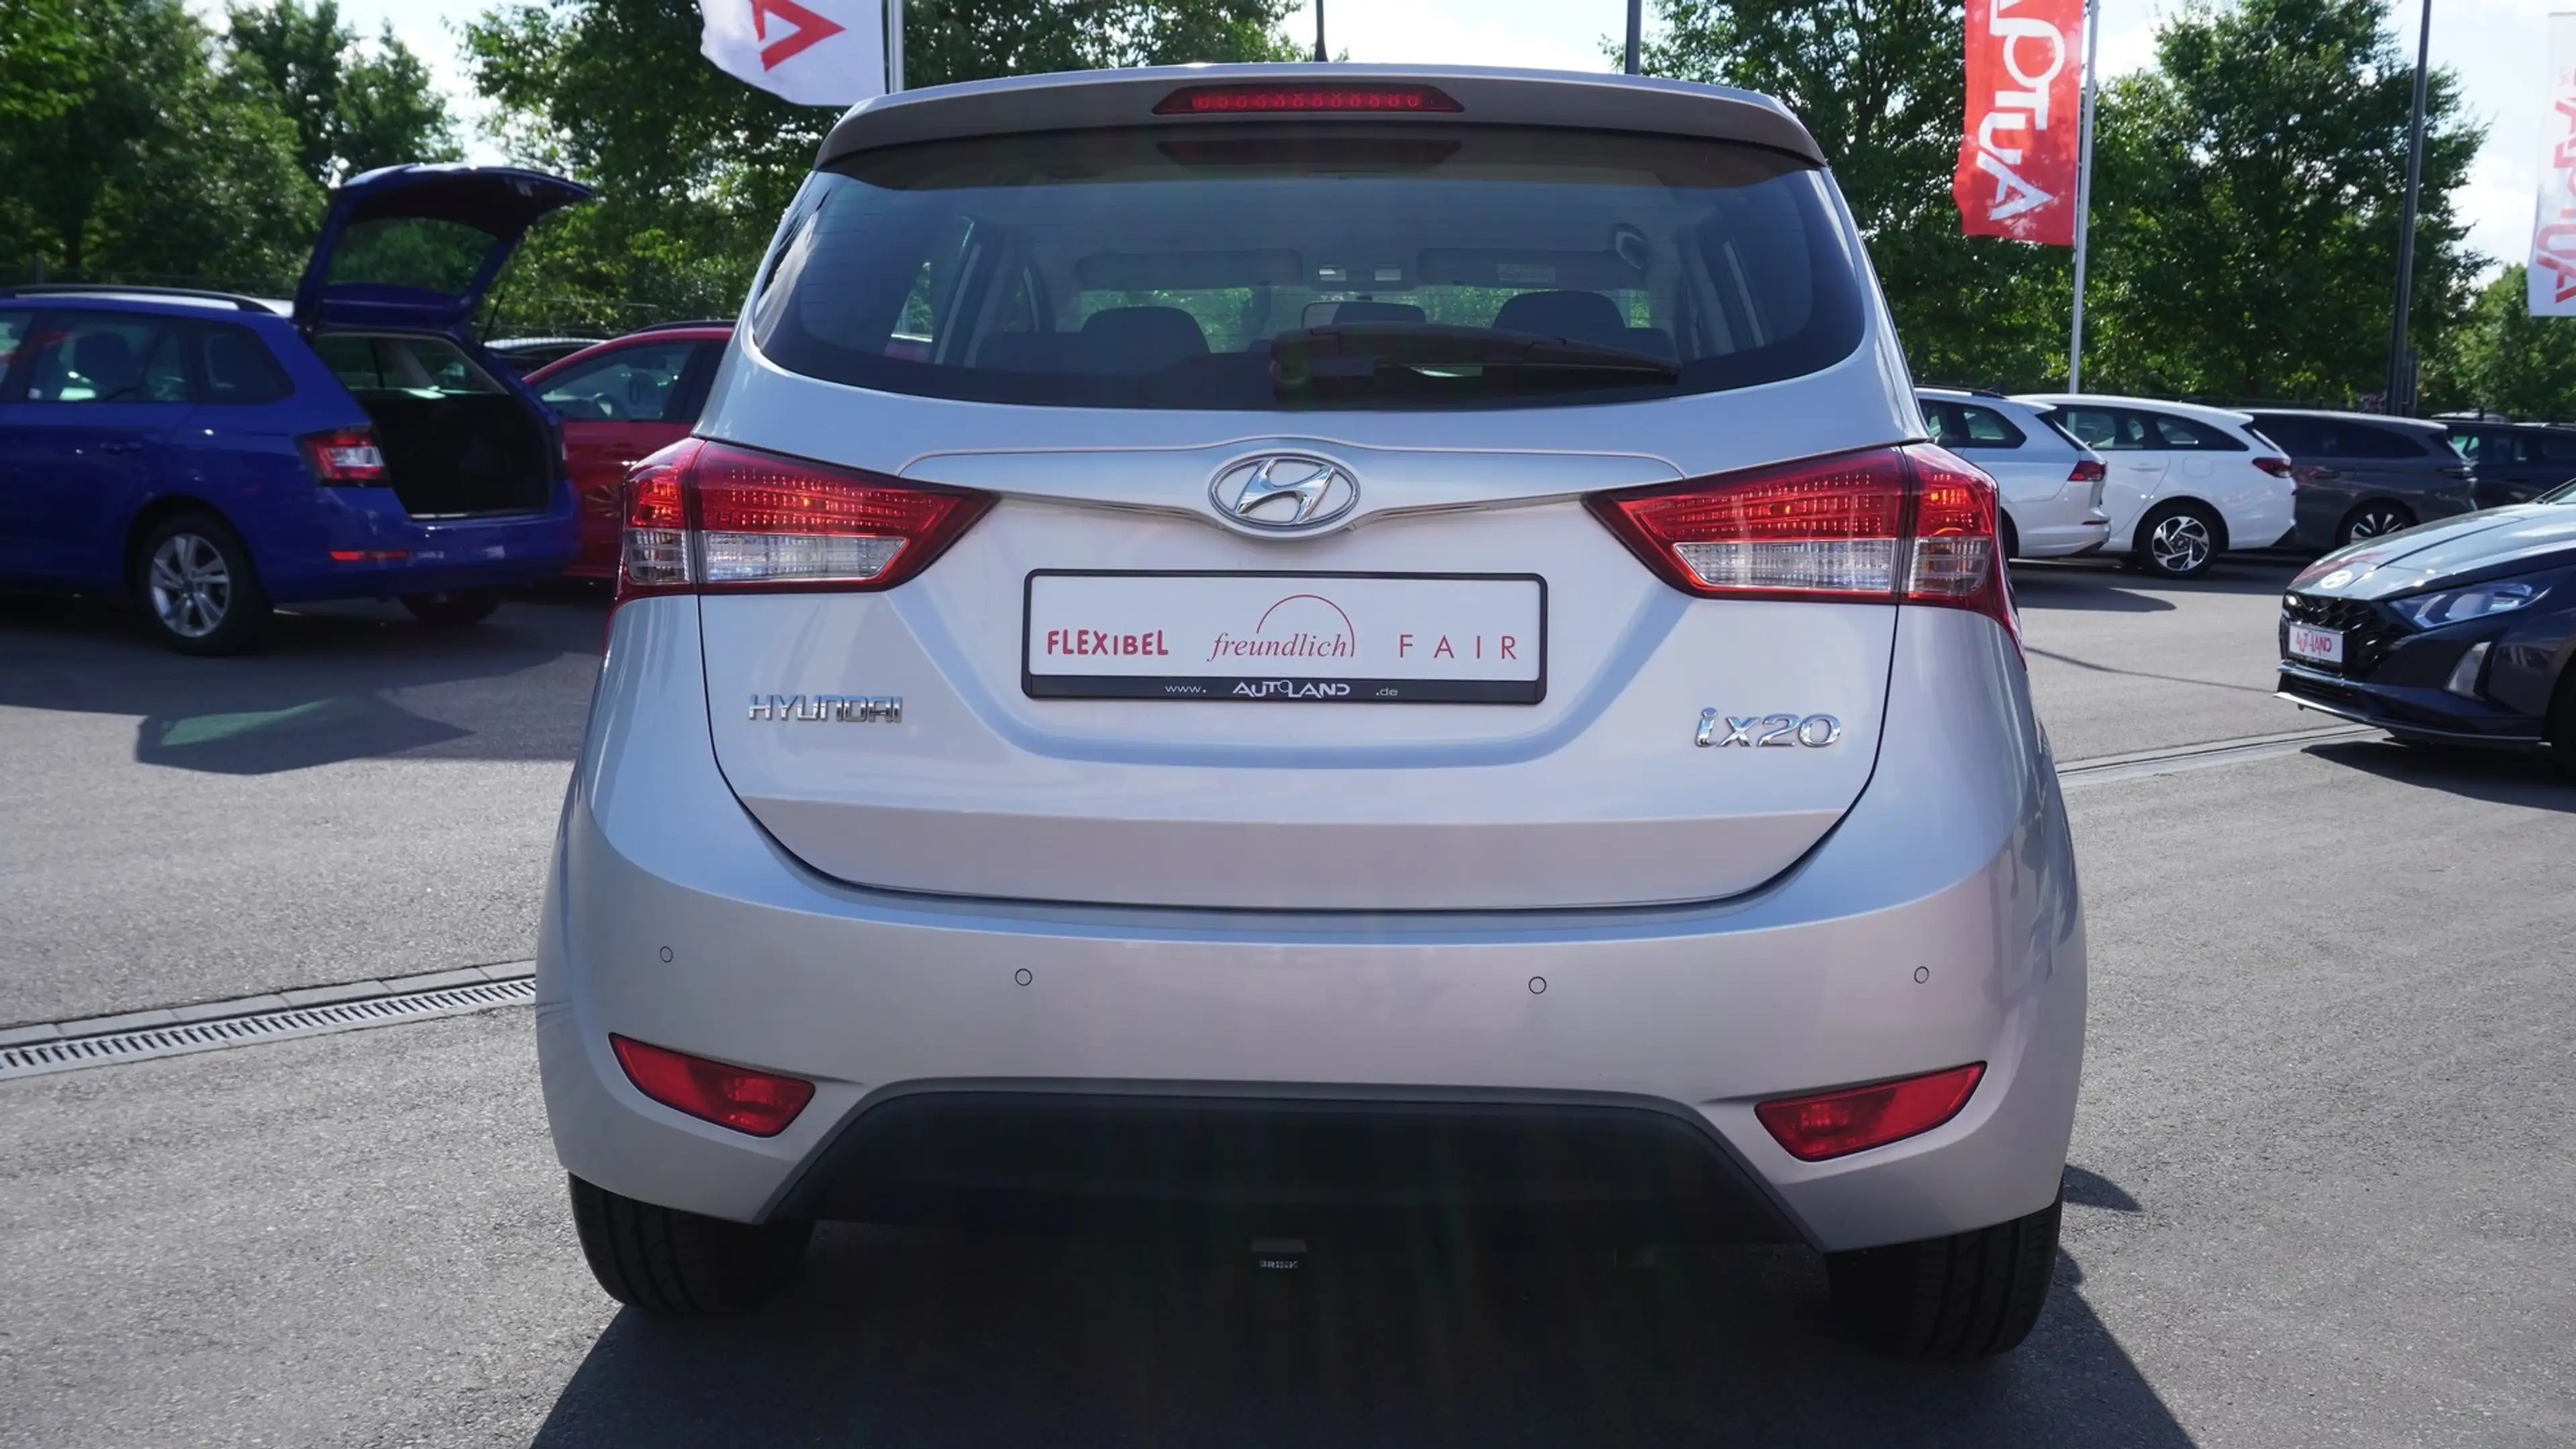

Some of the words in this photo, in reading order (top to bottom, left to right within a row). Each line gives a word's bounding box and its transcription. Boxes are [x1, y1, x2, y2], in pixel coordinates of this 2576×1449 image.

[1046, 628, 1169, 657] FLEXIBEL
[1206, 632, 1348, 662] freundlich
[1399, 634, 1517, 660] FAIR
[1164, 684, 1208, 694] www.
[1232, 679, 1351, 699] AUTOLAND
[1375, 686, 1399, 696] .de
[747, 694, 903, 724] HYUNDAI
[1694, 706, 1841, 748] ix20
[1258, 1258, 1299, 1270] BRINK
